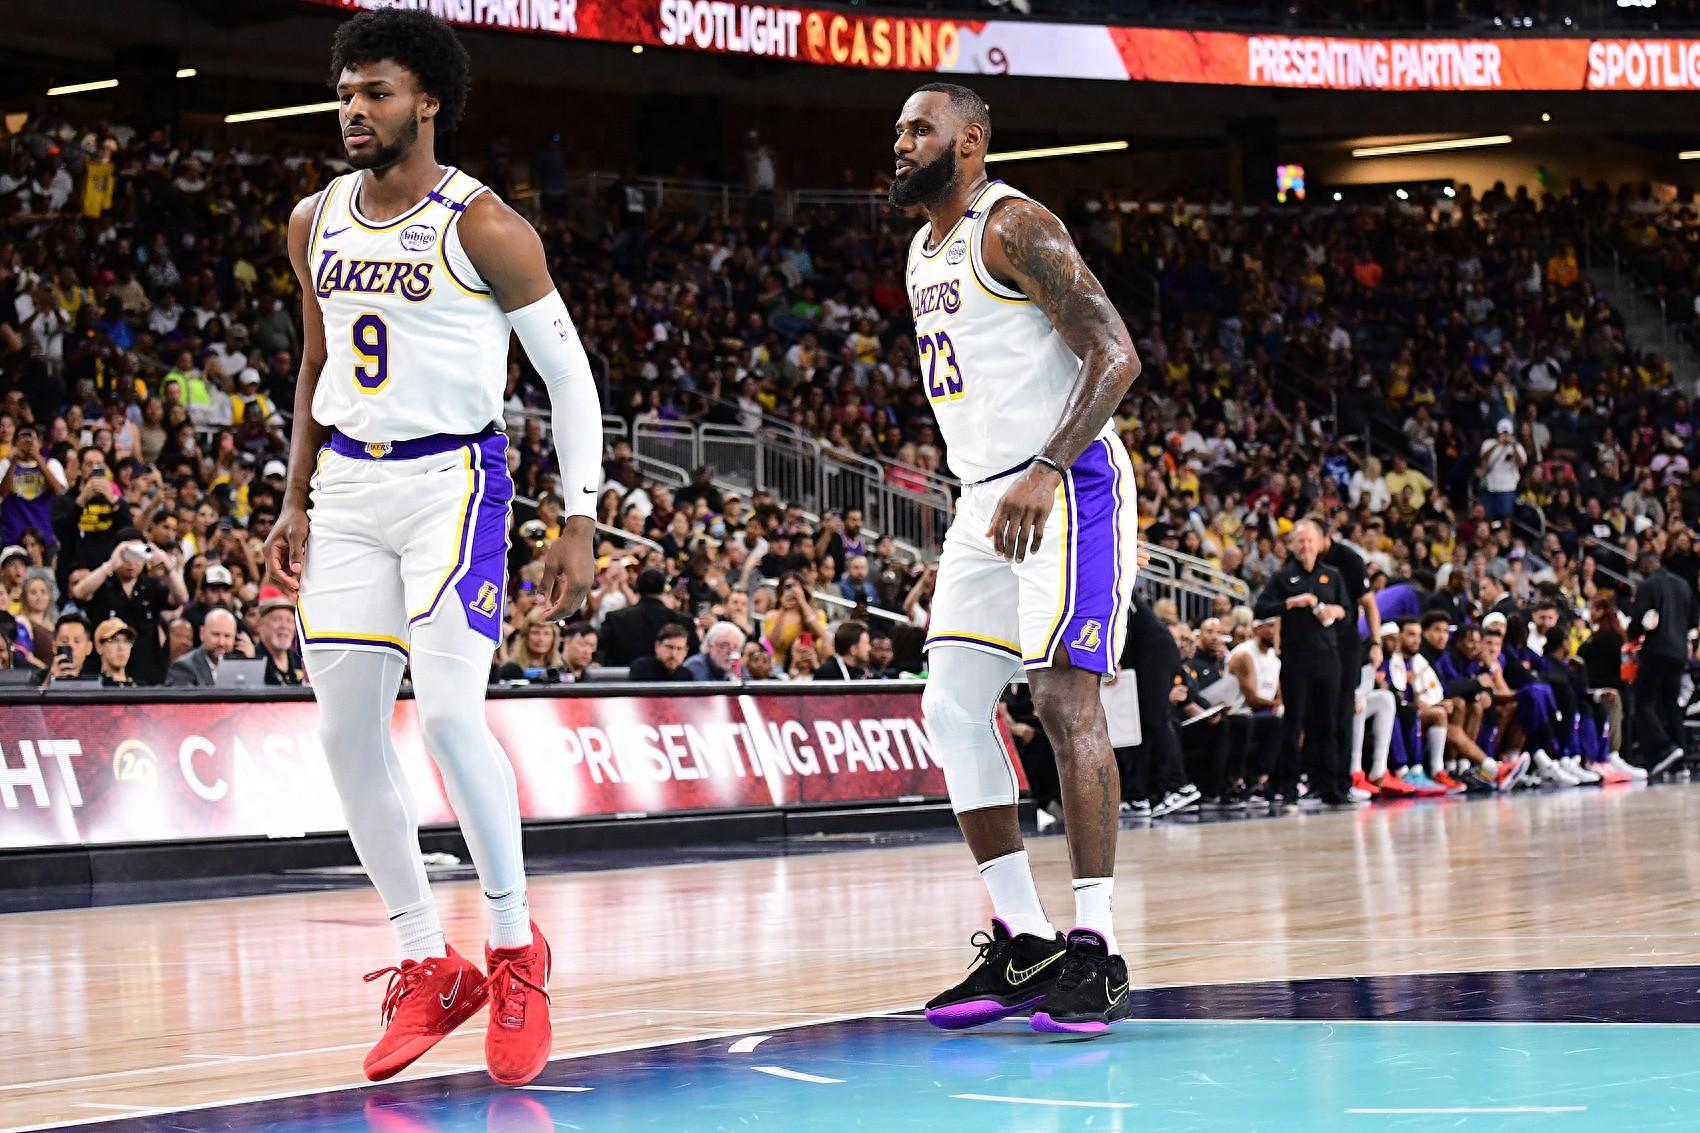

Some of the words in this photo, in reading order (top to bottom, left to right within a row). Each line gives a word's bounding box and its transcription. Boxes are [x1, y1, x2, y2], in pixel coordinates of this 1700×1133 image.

[659, 0, 802, 58] SPOTLIGHT
[1248, 36, 1389, 87] PRESENTING
[1391, 41, 1501, 87] PARTNER
[404, 231, 435, 244] bibigo
[316, 249, 434, 302] LAKERS
[352, 313, 389, 392] 9
[917, 329, 965, 402] 23
